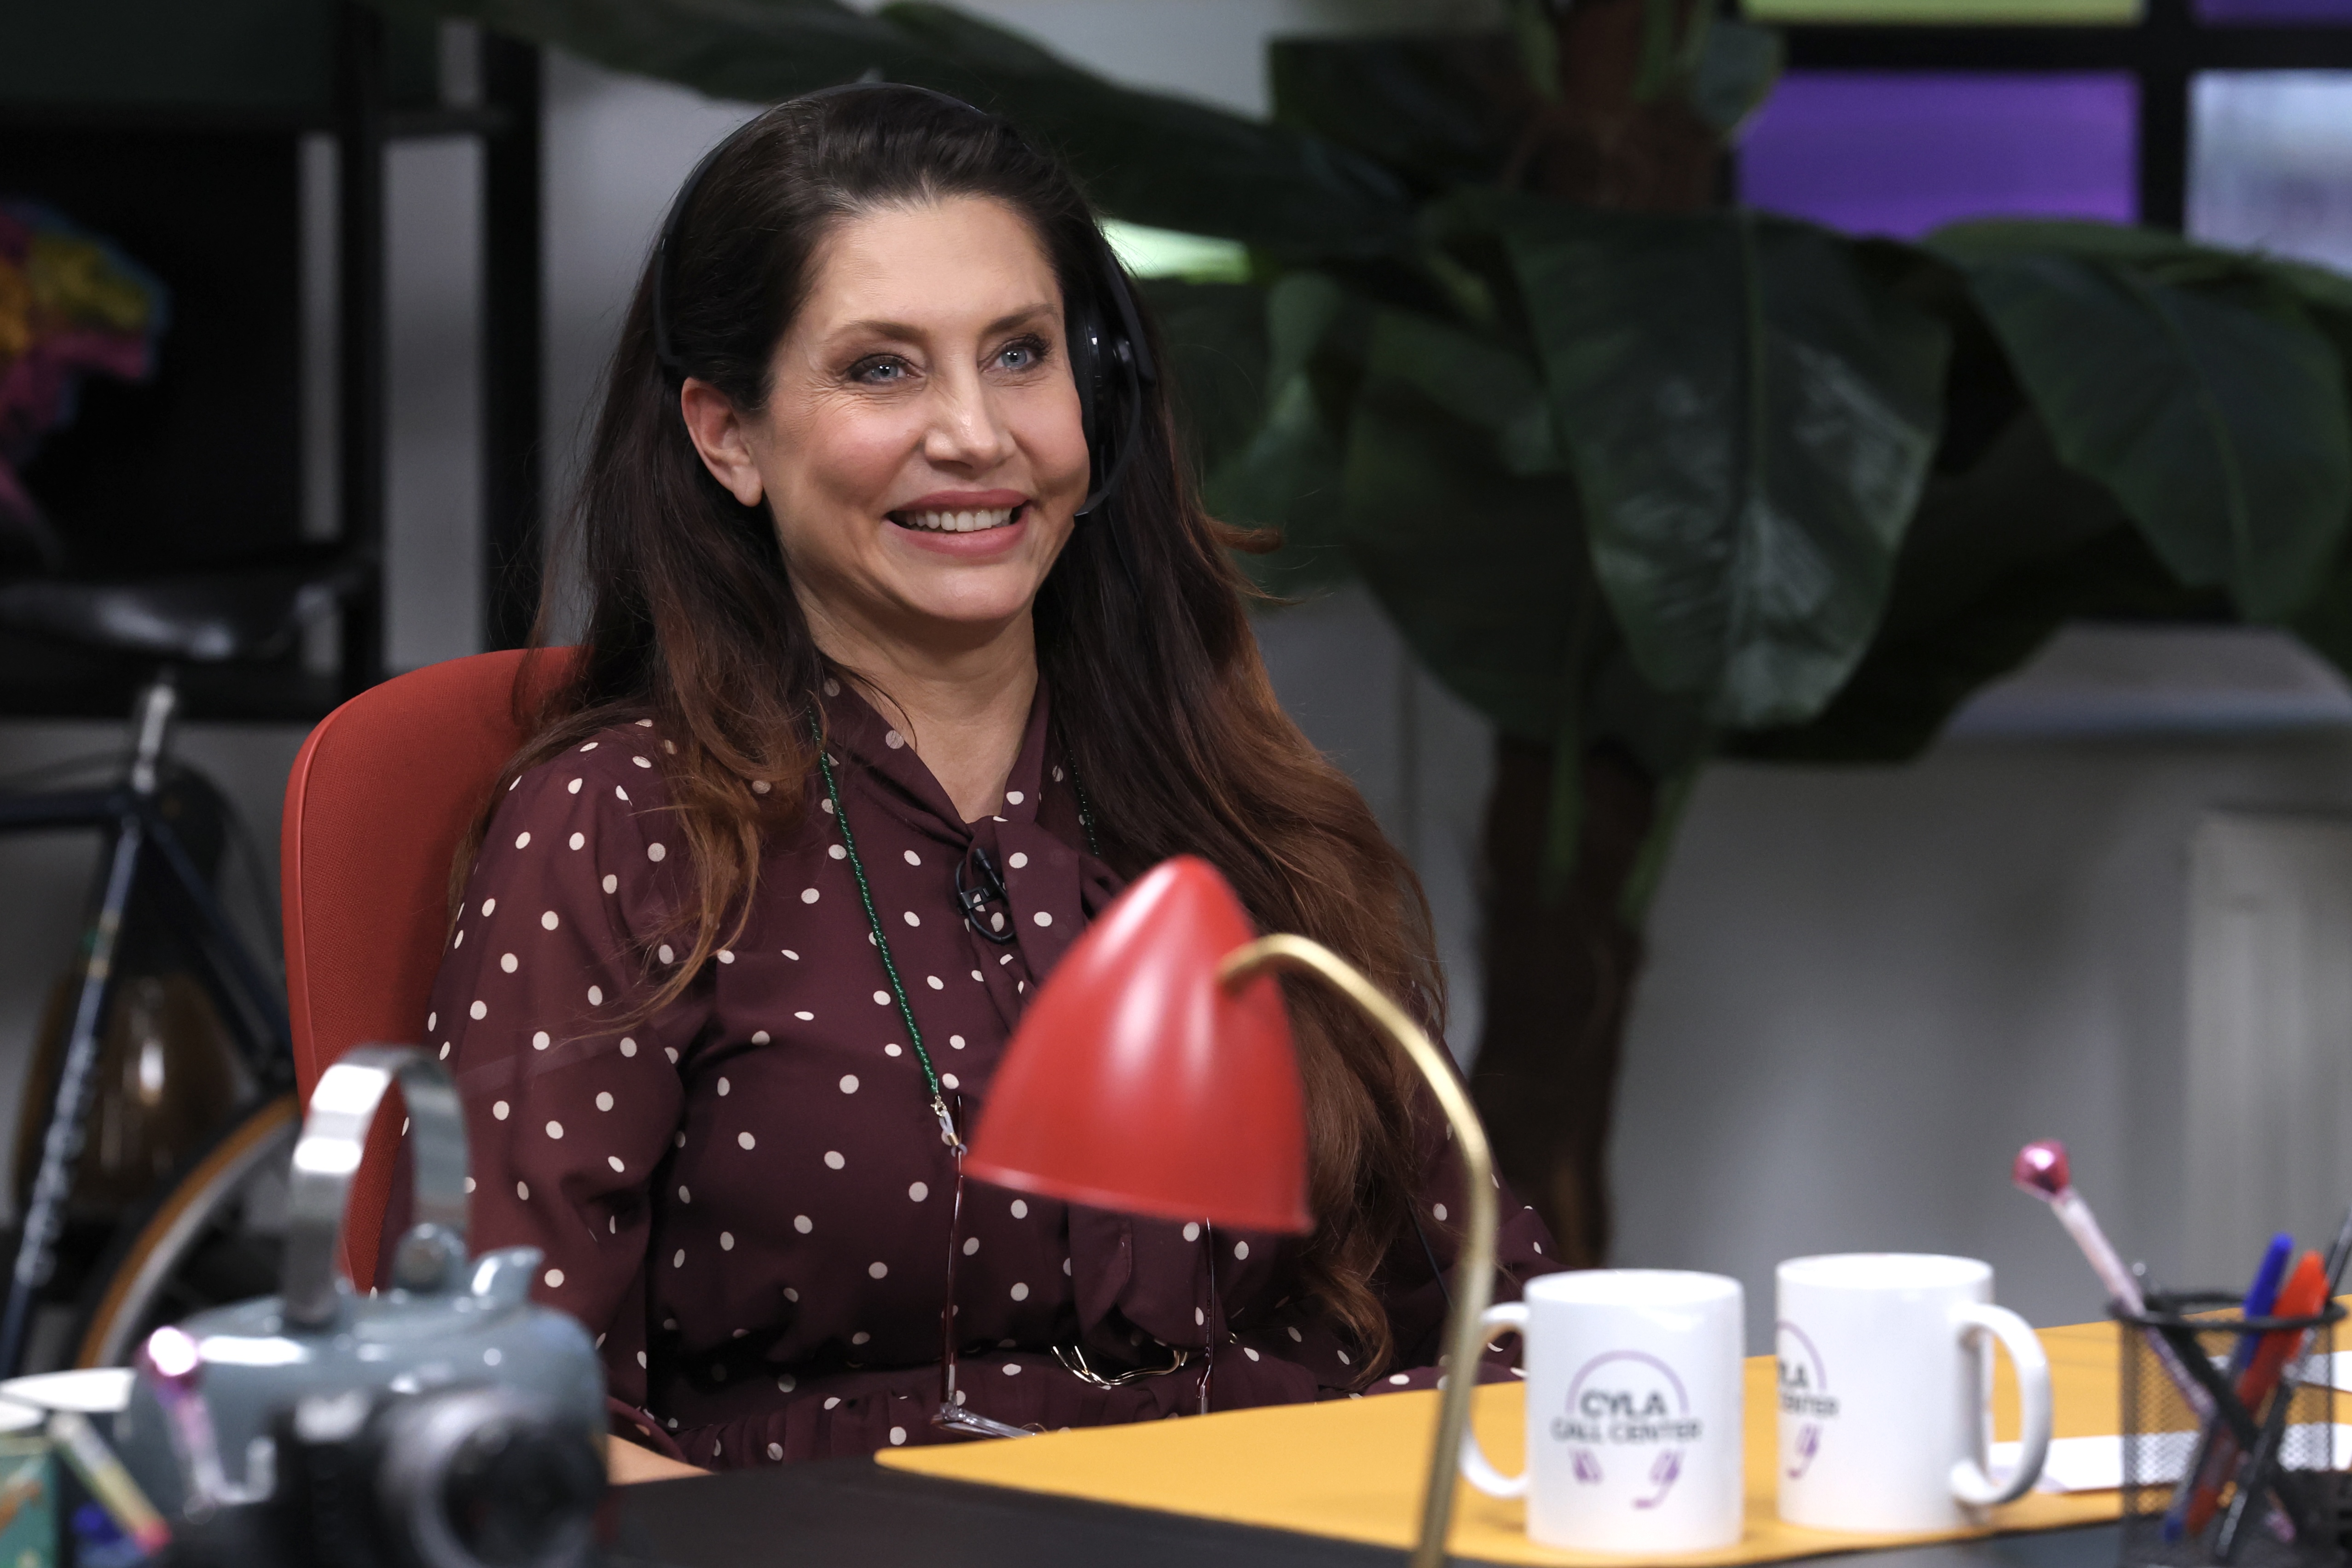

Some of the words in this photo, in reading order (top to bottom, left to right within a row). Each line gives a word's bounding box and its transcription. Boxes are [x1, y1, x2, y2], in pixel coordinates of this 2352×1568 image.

[1580, 1389, 1667, 1418] CYLA
[1778, 1393, 1840, 1418] ENTER
[1550, 1417, 1601, 1443] CALL
[1609, 1418, 1703, 1444] CENTER
